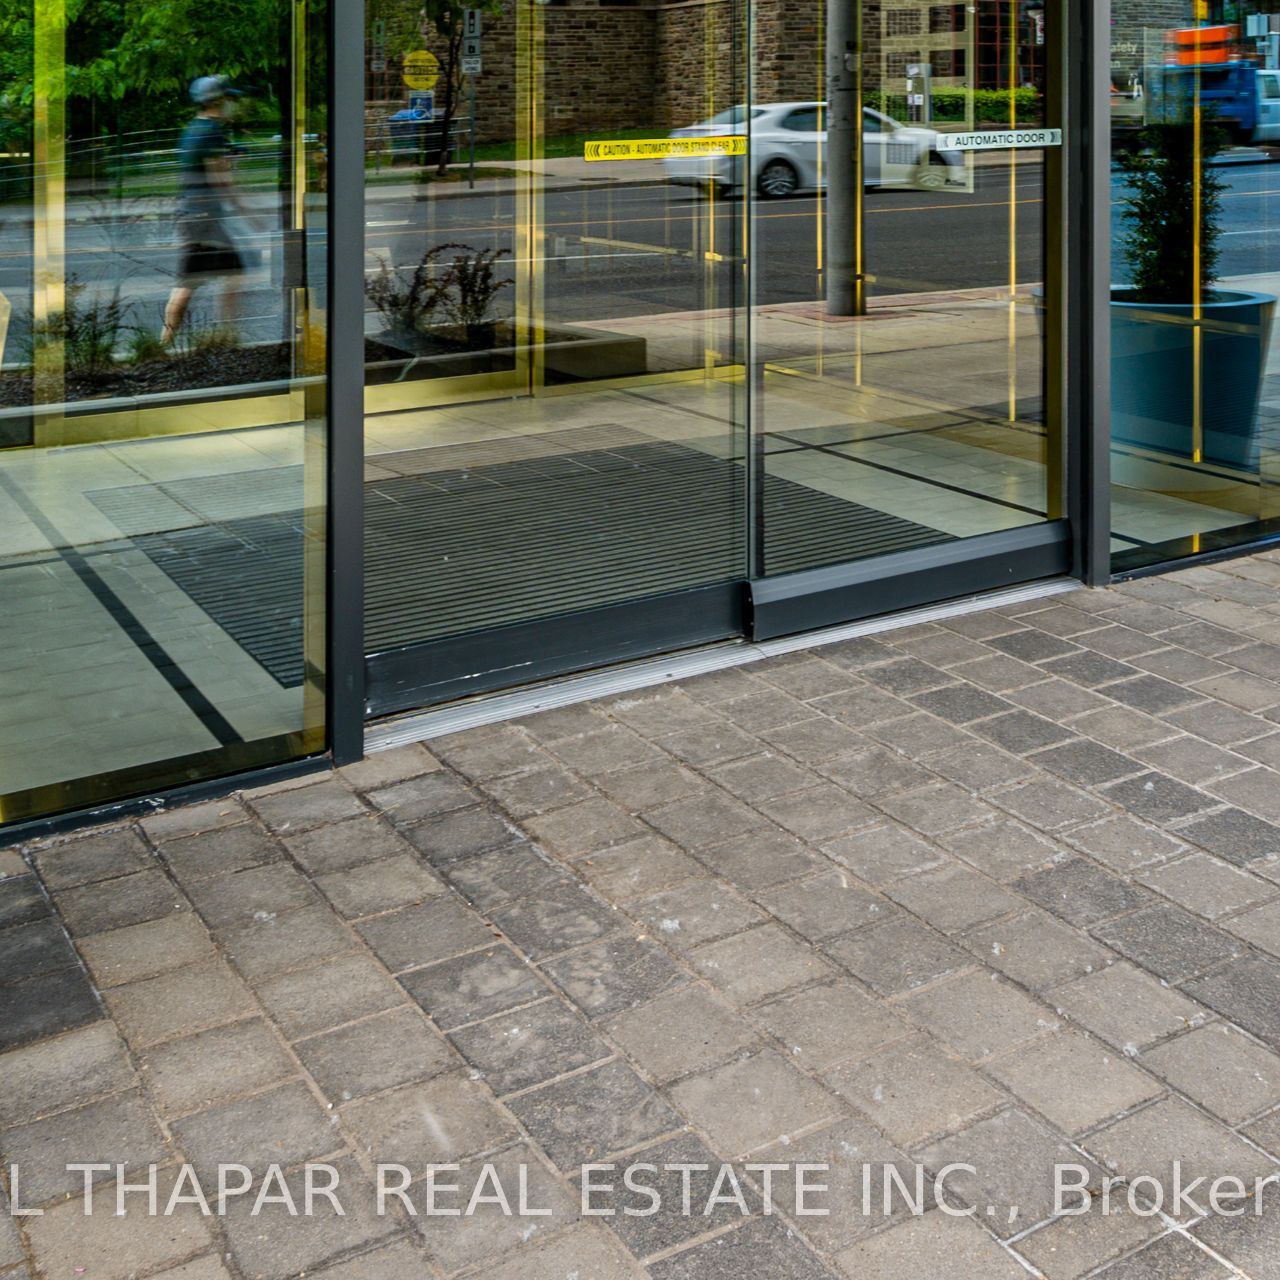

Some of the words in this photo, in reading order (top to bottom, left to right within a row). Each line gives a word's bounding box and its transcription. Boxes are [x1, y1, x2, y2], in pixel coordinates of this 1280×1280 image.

[955, 134, 1014, 145] AUTOMATIC
[1016, 133, 1045, 143] DOOR
[603, 144, 630, 155] CAUTION
[637, 143, 670, 154] AUTOMATIC
